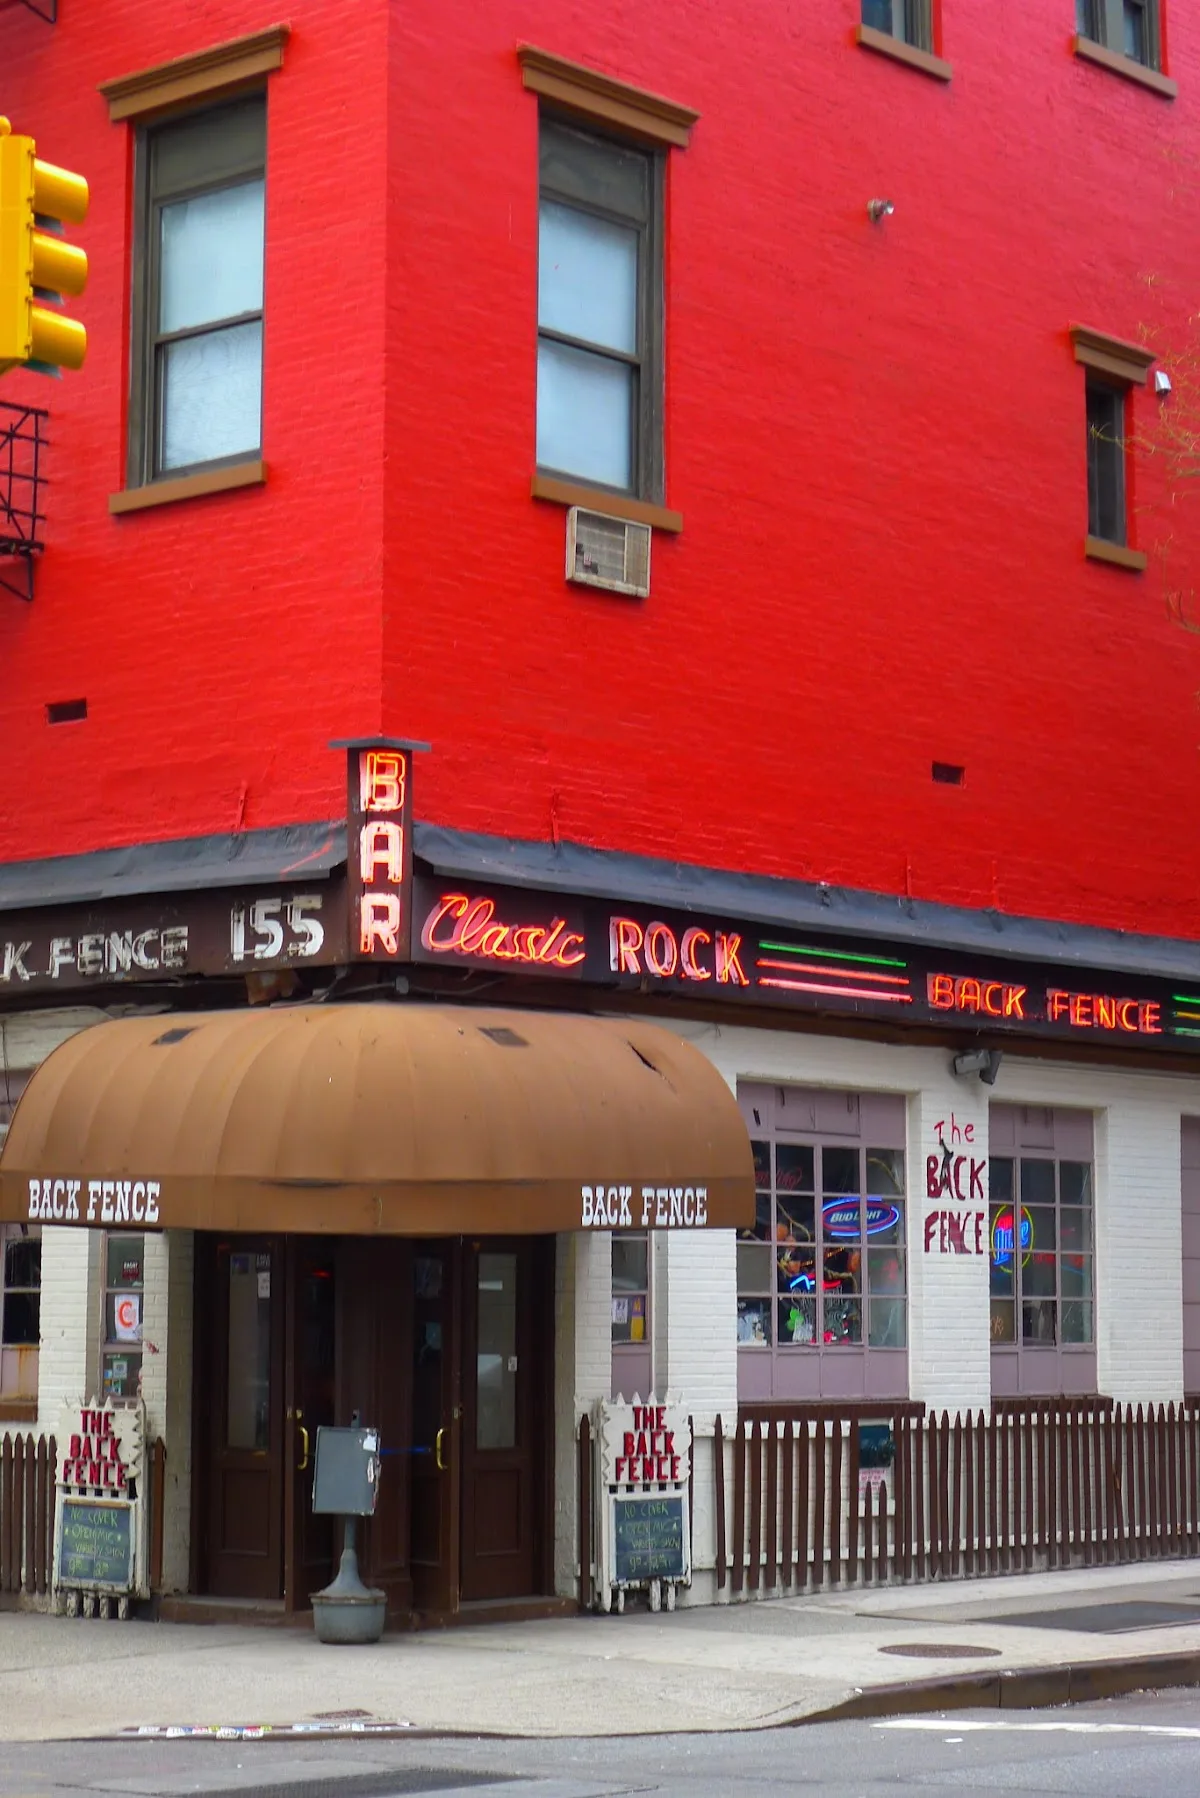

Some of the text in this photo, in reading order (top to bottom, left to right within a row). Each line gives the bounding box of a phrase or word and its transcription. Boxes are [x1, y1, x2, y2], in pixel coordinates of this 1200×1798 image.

[360, 751, 406, 954] BAR
[230, 894, 325, 961] 155
[421, 895, 750, 986] Classic ROCK
[49, 925, 189, 980] FENCE
[926, 972, 1162, 1034] BACK FENCE
[933, 1112, 975, 1146] The
[926, 1154, 987, 1201] BACK
[28, 1179, 161, 1223] BACK FENCE
[581, 1186, 707, 1226] BACK FENCE
[830, 1209, 883, 1224] BUD LHT
[924, 1210, 985, 1255] FENCE
[118, 1300, 133, 1329] C
[81, 1409, 115, 1436] THE
[633, 1405, 667, 1431] THE
[70, 1433, 122, 1463] BACK
[623, 1431, 675, 1458] BACK
[63, 1459, 129, 1489] FENCE
[615, 1456, 681, 1483] FENCE
